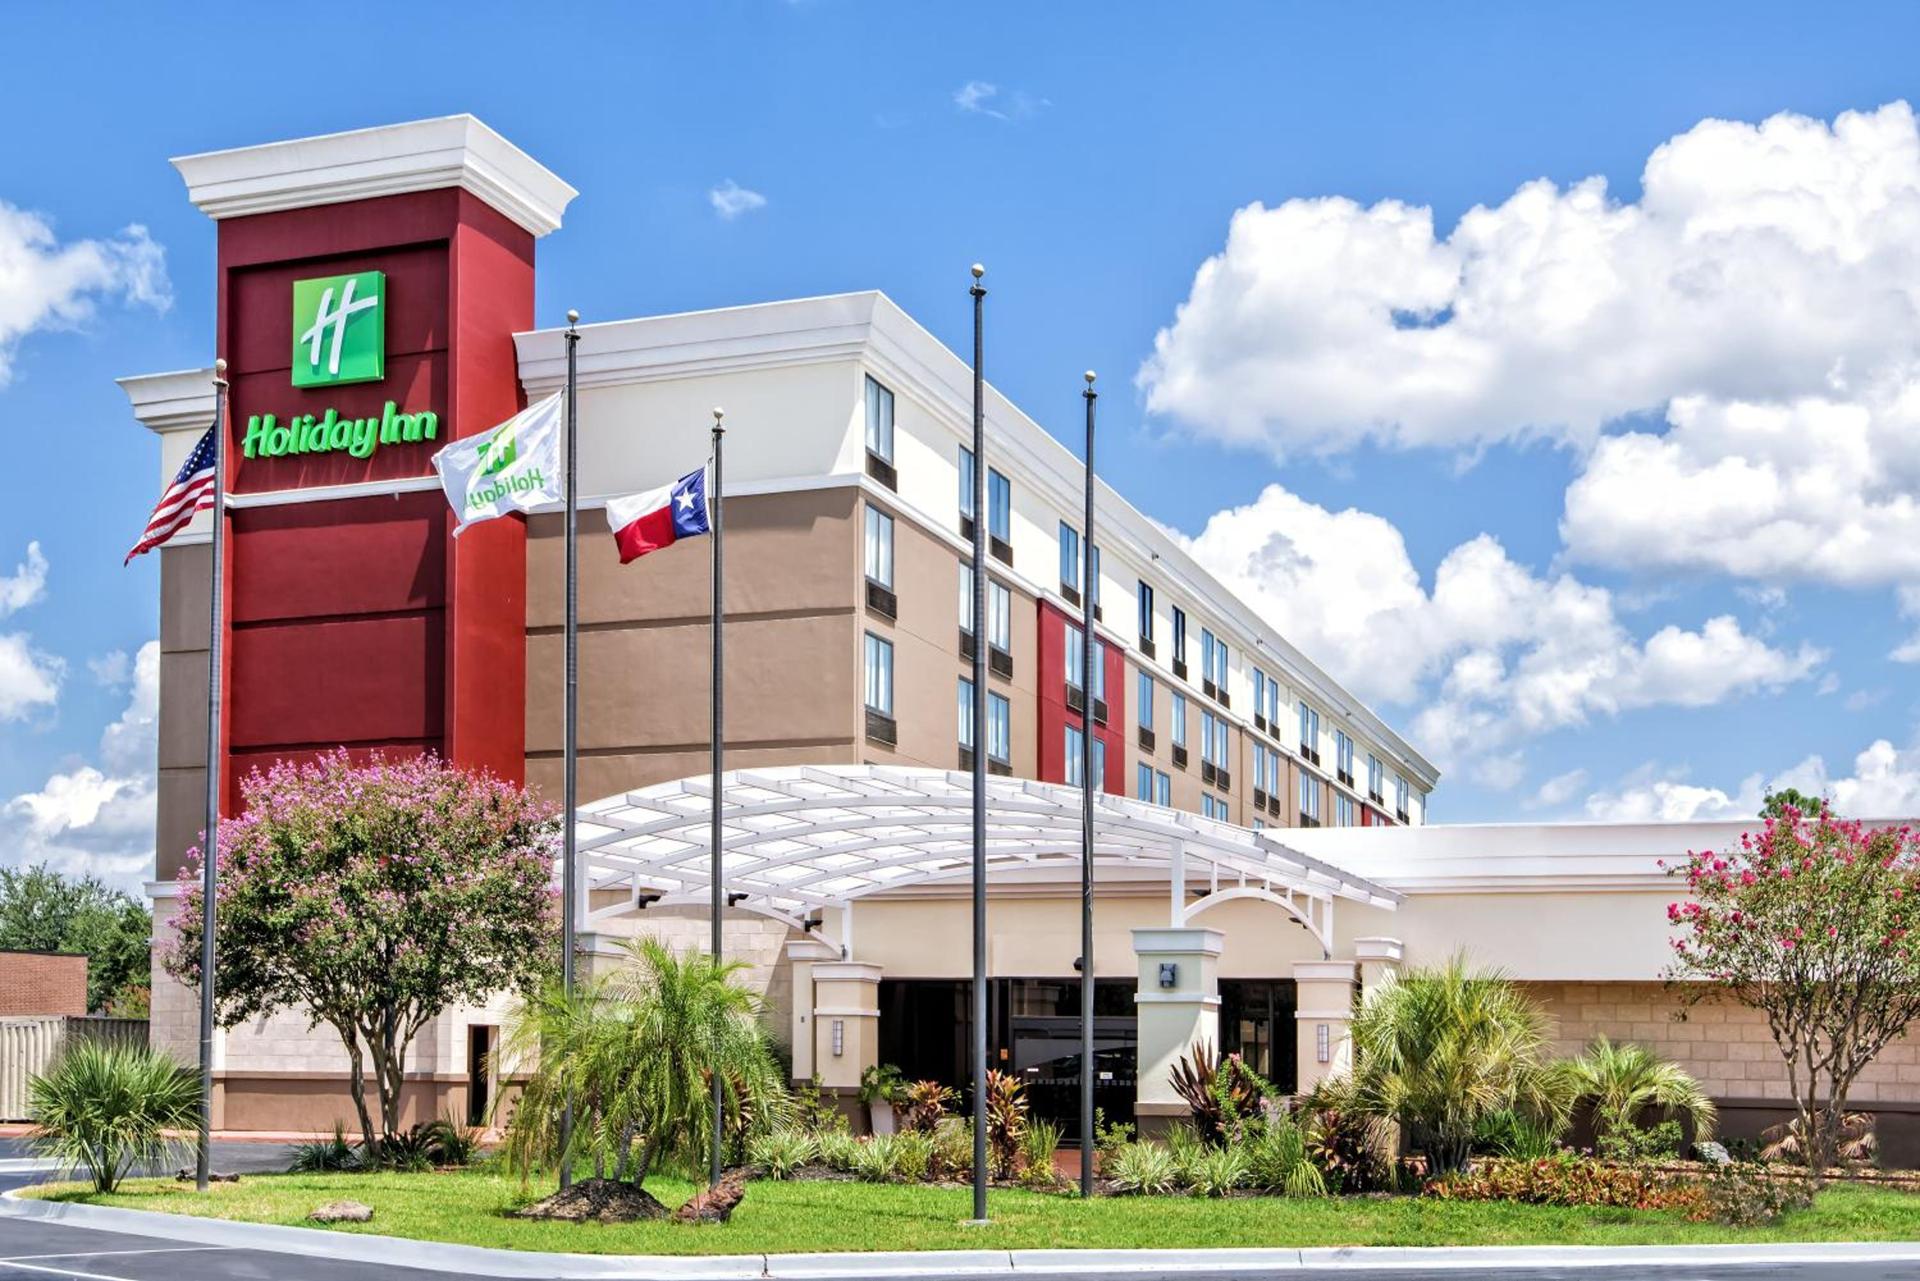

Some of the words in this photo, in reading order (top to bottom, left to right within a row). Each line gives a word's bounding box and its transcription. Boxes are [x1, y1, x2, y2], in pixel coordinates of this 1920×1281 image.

[301, 279, 378, 374] H
[242, 408, 379, 459] Holiday
[380, 401, 439, 443] Inn
